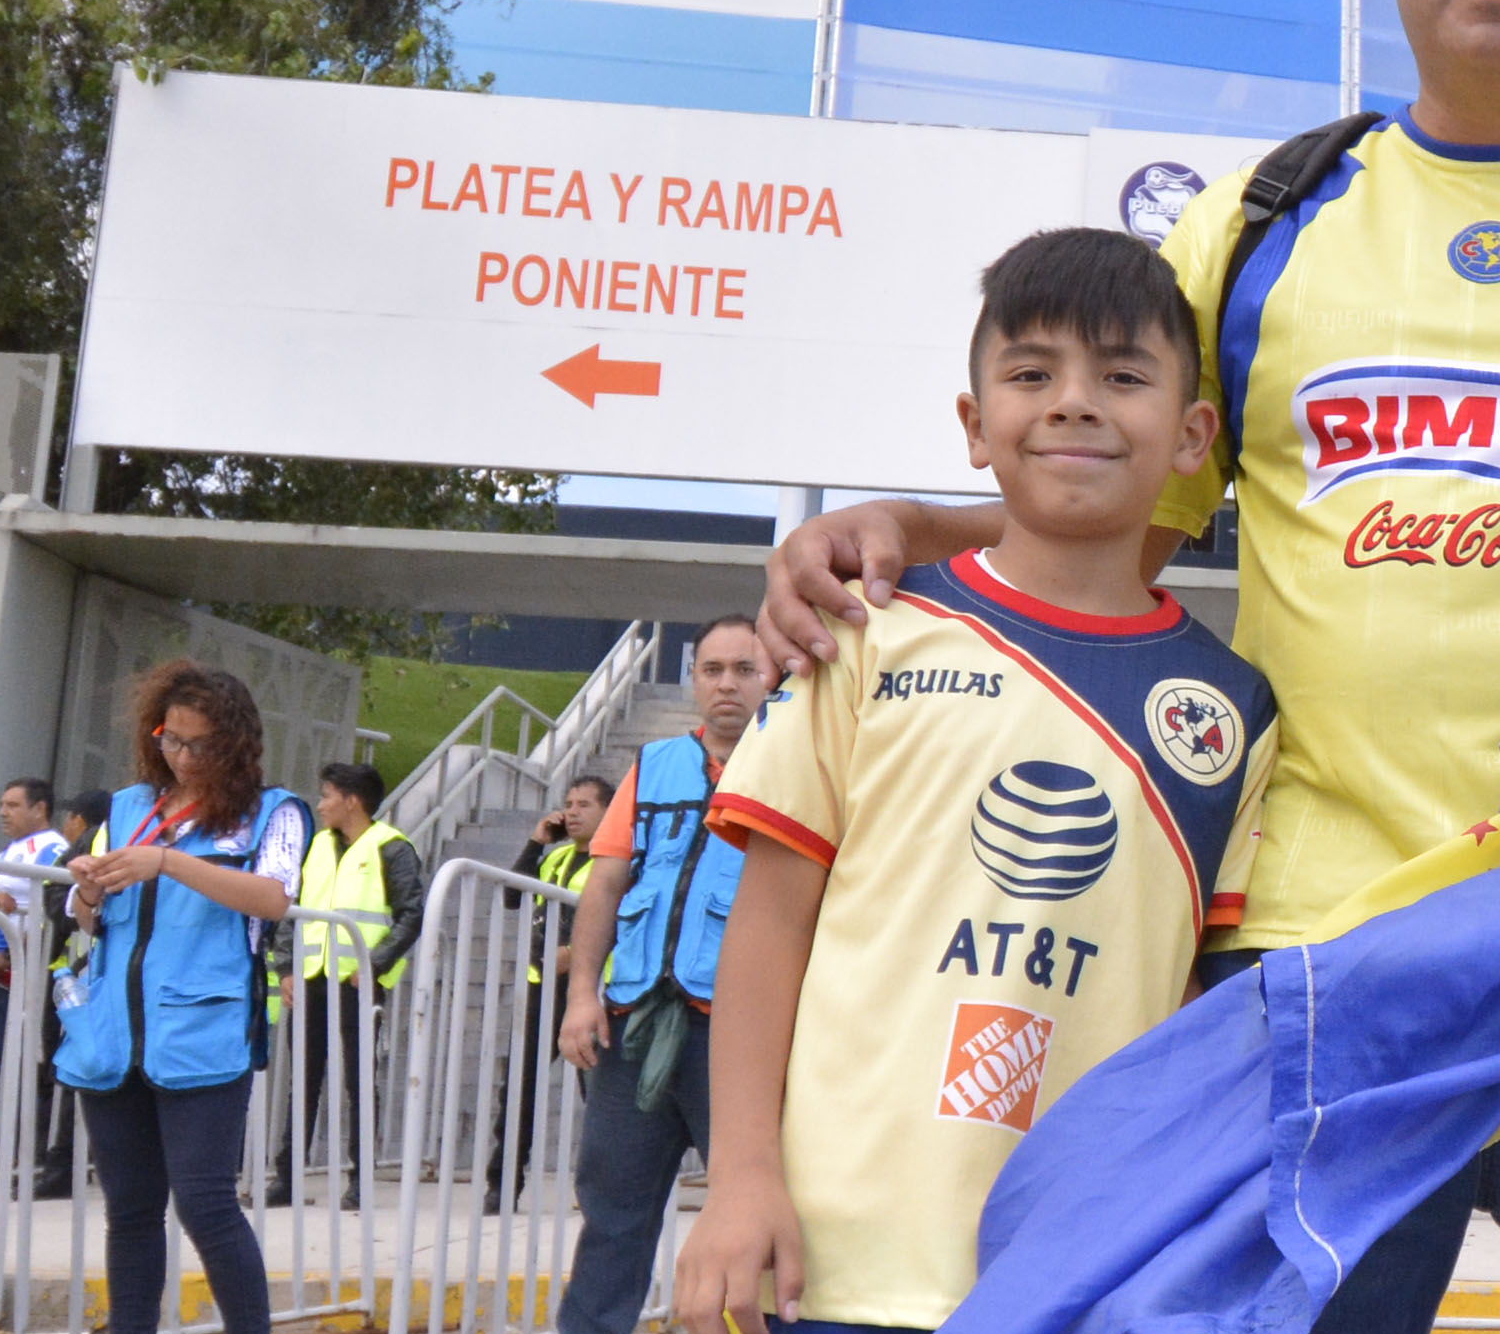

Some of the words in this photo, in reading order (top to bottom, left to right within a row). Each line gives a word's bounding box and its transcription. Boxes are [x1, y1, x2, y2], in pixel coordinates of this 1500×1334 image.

[385, 157, 592, 220] PLATEA
[610, 172, 643, 223] Y
[657, 176, 843, 237] RAMPA
[475, 251, 747, 320] PONIENTE
[871, 669, 1004, 701] AGUILAS
[936, 918, 1099, 997] AT&T
[941, 1016, 1053, 1118] HOME
[960, 1016, 1012, 1060] THE
